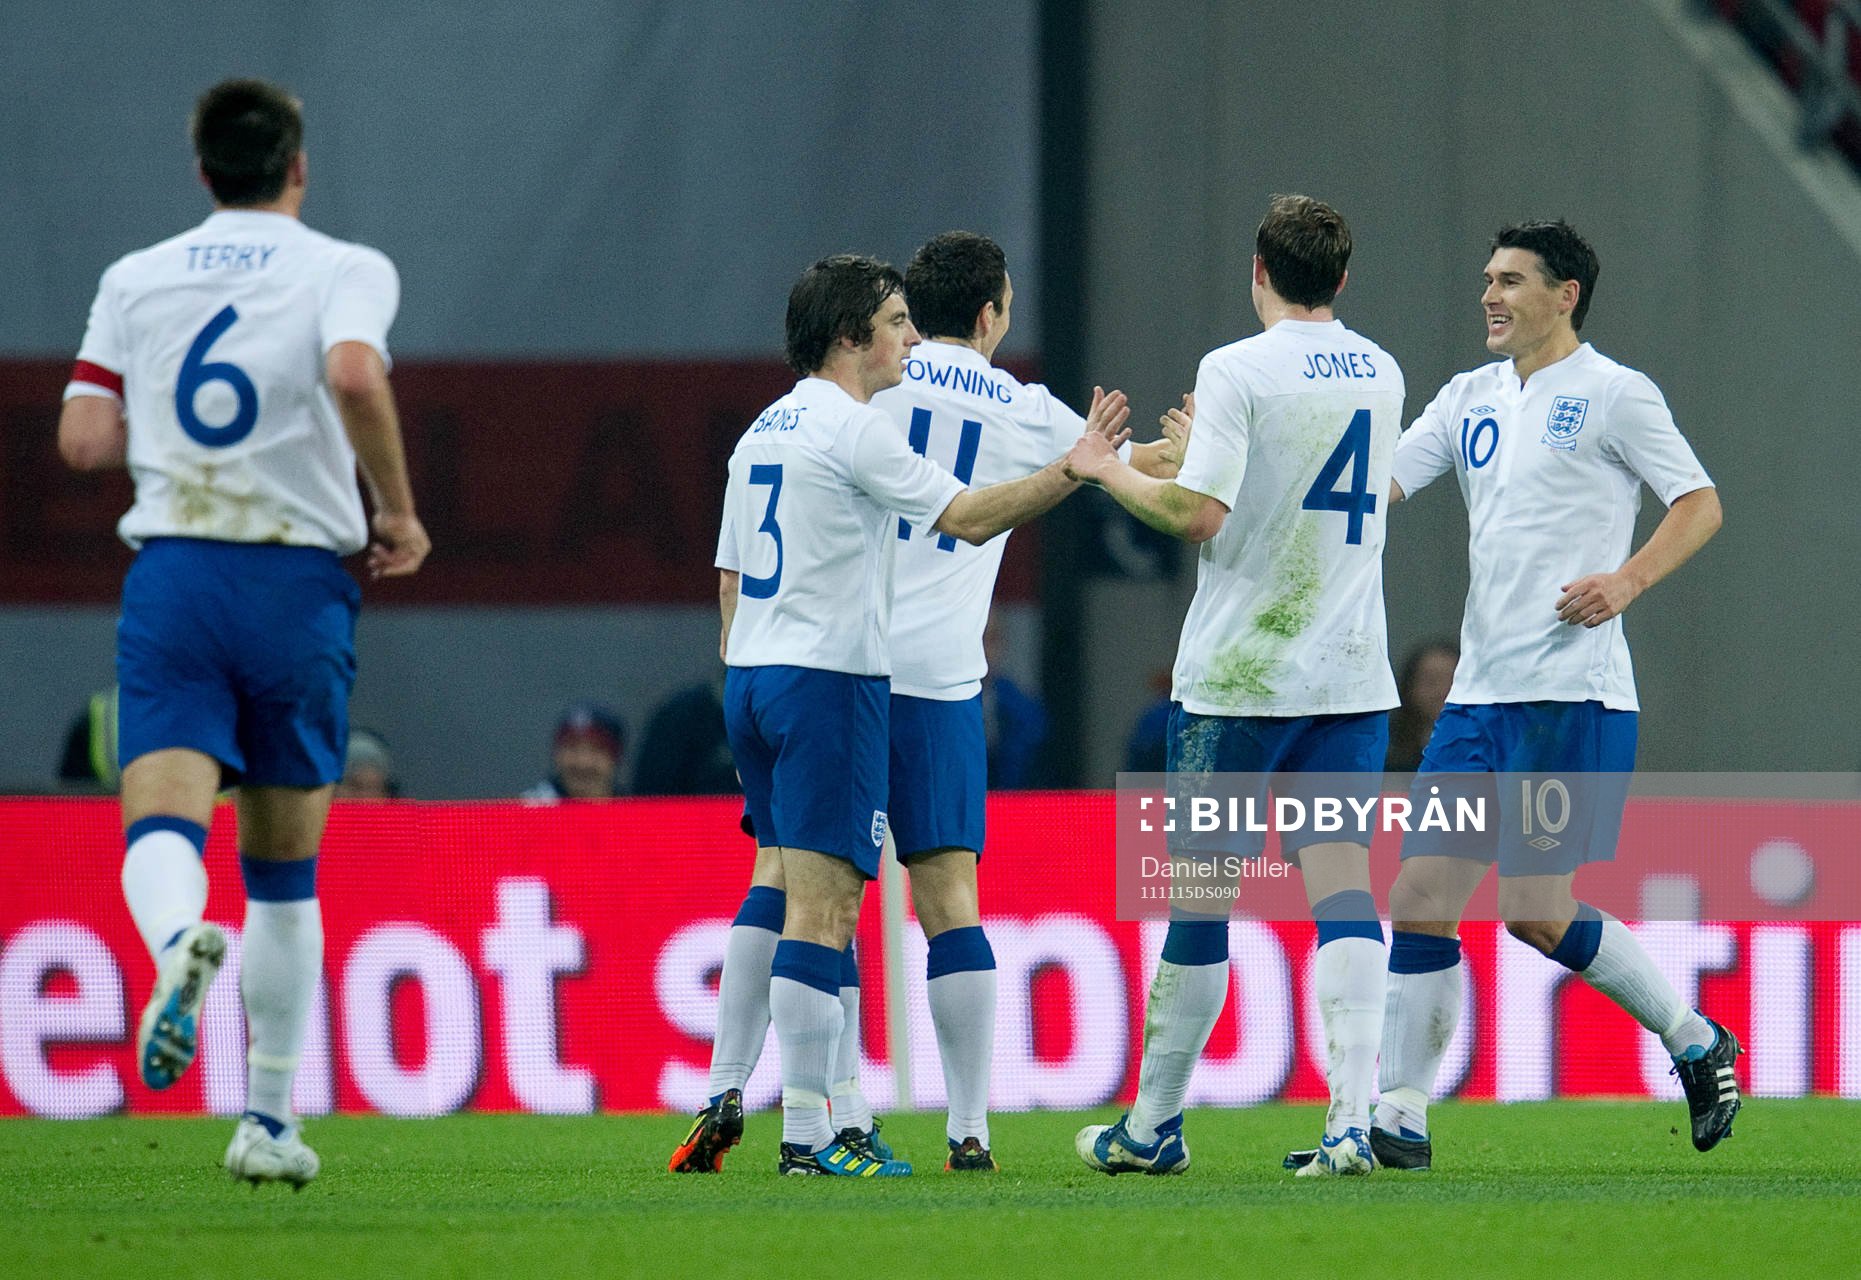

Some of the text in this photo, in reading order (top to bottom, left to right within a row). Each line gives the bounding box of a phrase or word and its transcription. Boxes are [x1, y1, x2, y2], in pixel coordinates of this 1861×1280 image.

[186, 244, 278, 271] TERRY
[175, 303, 258, 449] 6
[907, 359, 1012, 403] OWNING
[1303, 353, 1376, 379] JONES
[897, 406, 982, 552] 11
[1302, 409, 1377, 545] 4
[1461, 417, 1499, 471] 10
[741, 463, 783, 599] 3
[1522, 779, 1571, 833] 10
[203, 876, 597, 1117] not
[652, 836, 1861, 1119] spprti
